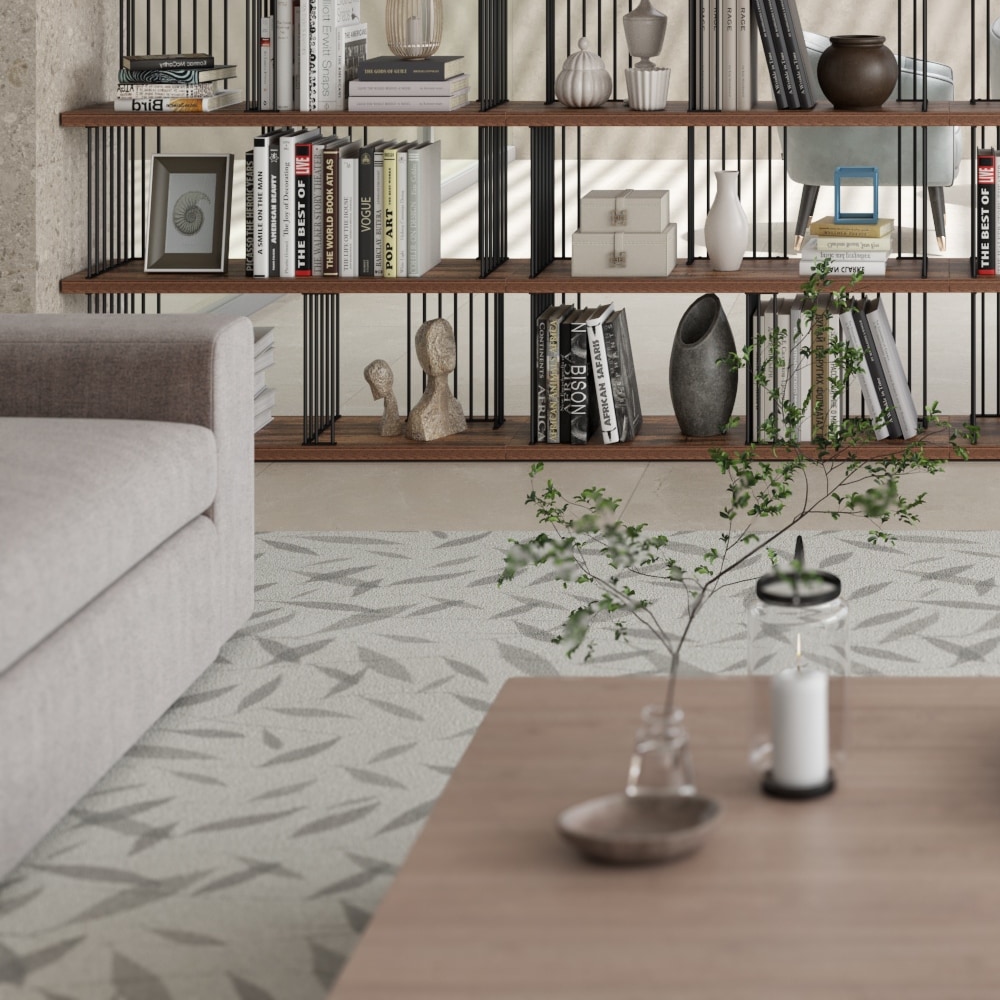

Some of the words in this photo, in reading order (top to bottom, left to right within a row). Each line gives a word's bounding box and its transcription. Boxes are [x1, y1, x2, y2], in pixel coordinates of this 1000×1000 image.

[321, 28, 332, 57] Erwitt
[321, 61, 332, 97] Snaps
[295, 157, 310, 175] LIVE
[298, 180, 305, 198] OF
[360, 196, 371, 232] VOGUE
[592, 339, 605, 379] SAFARIS
[570, 365, 587, 415] BISON
[598, 382, 612, 426] AFRICAN
[538, 385, 546, 441] AFRICA
